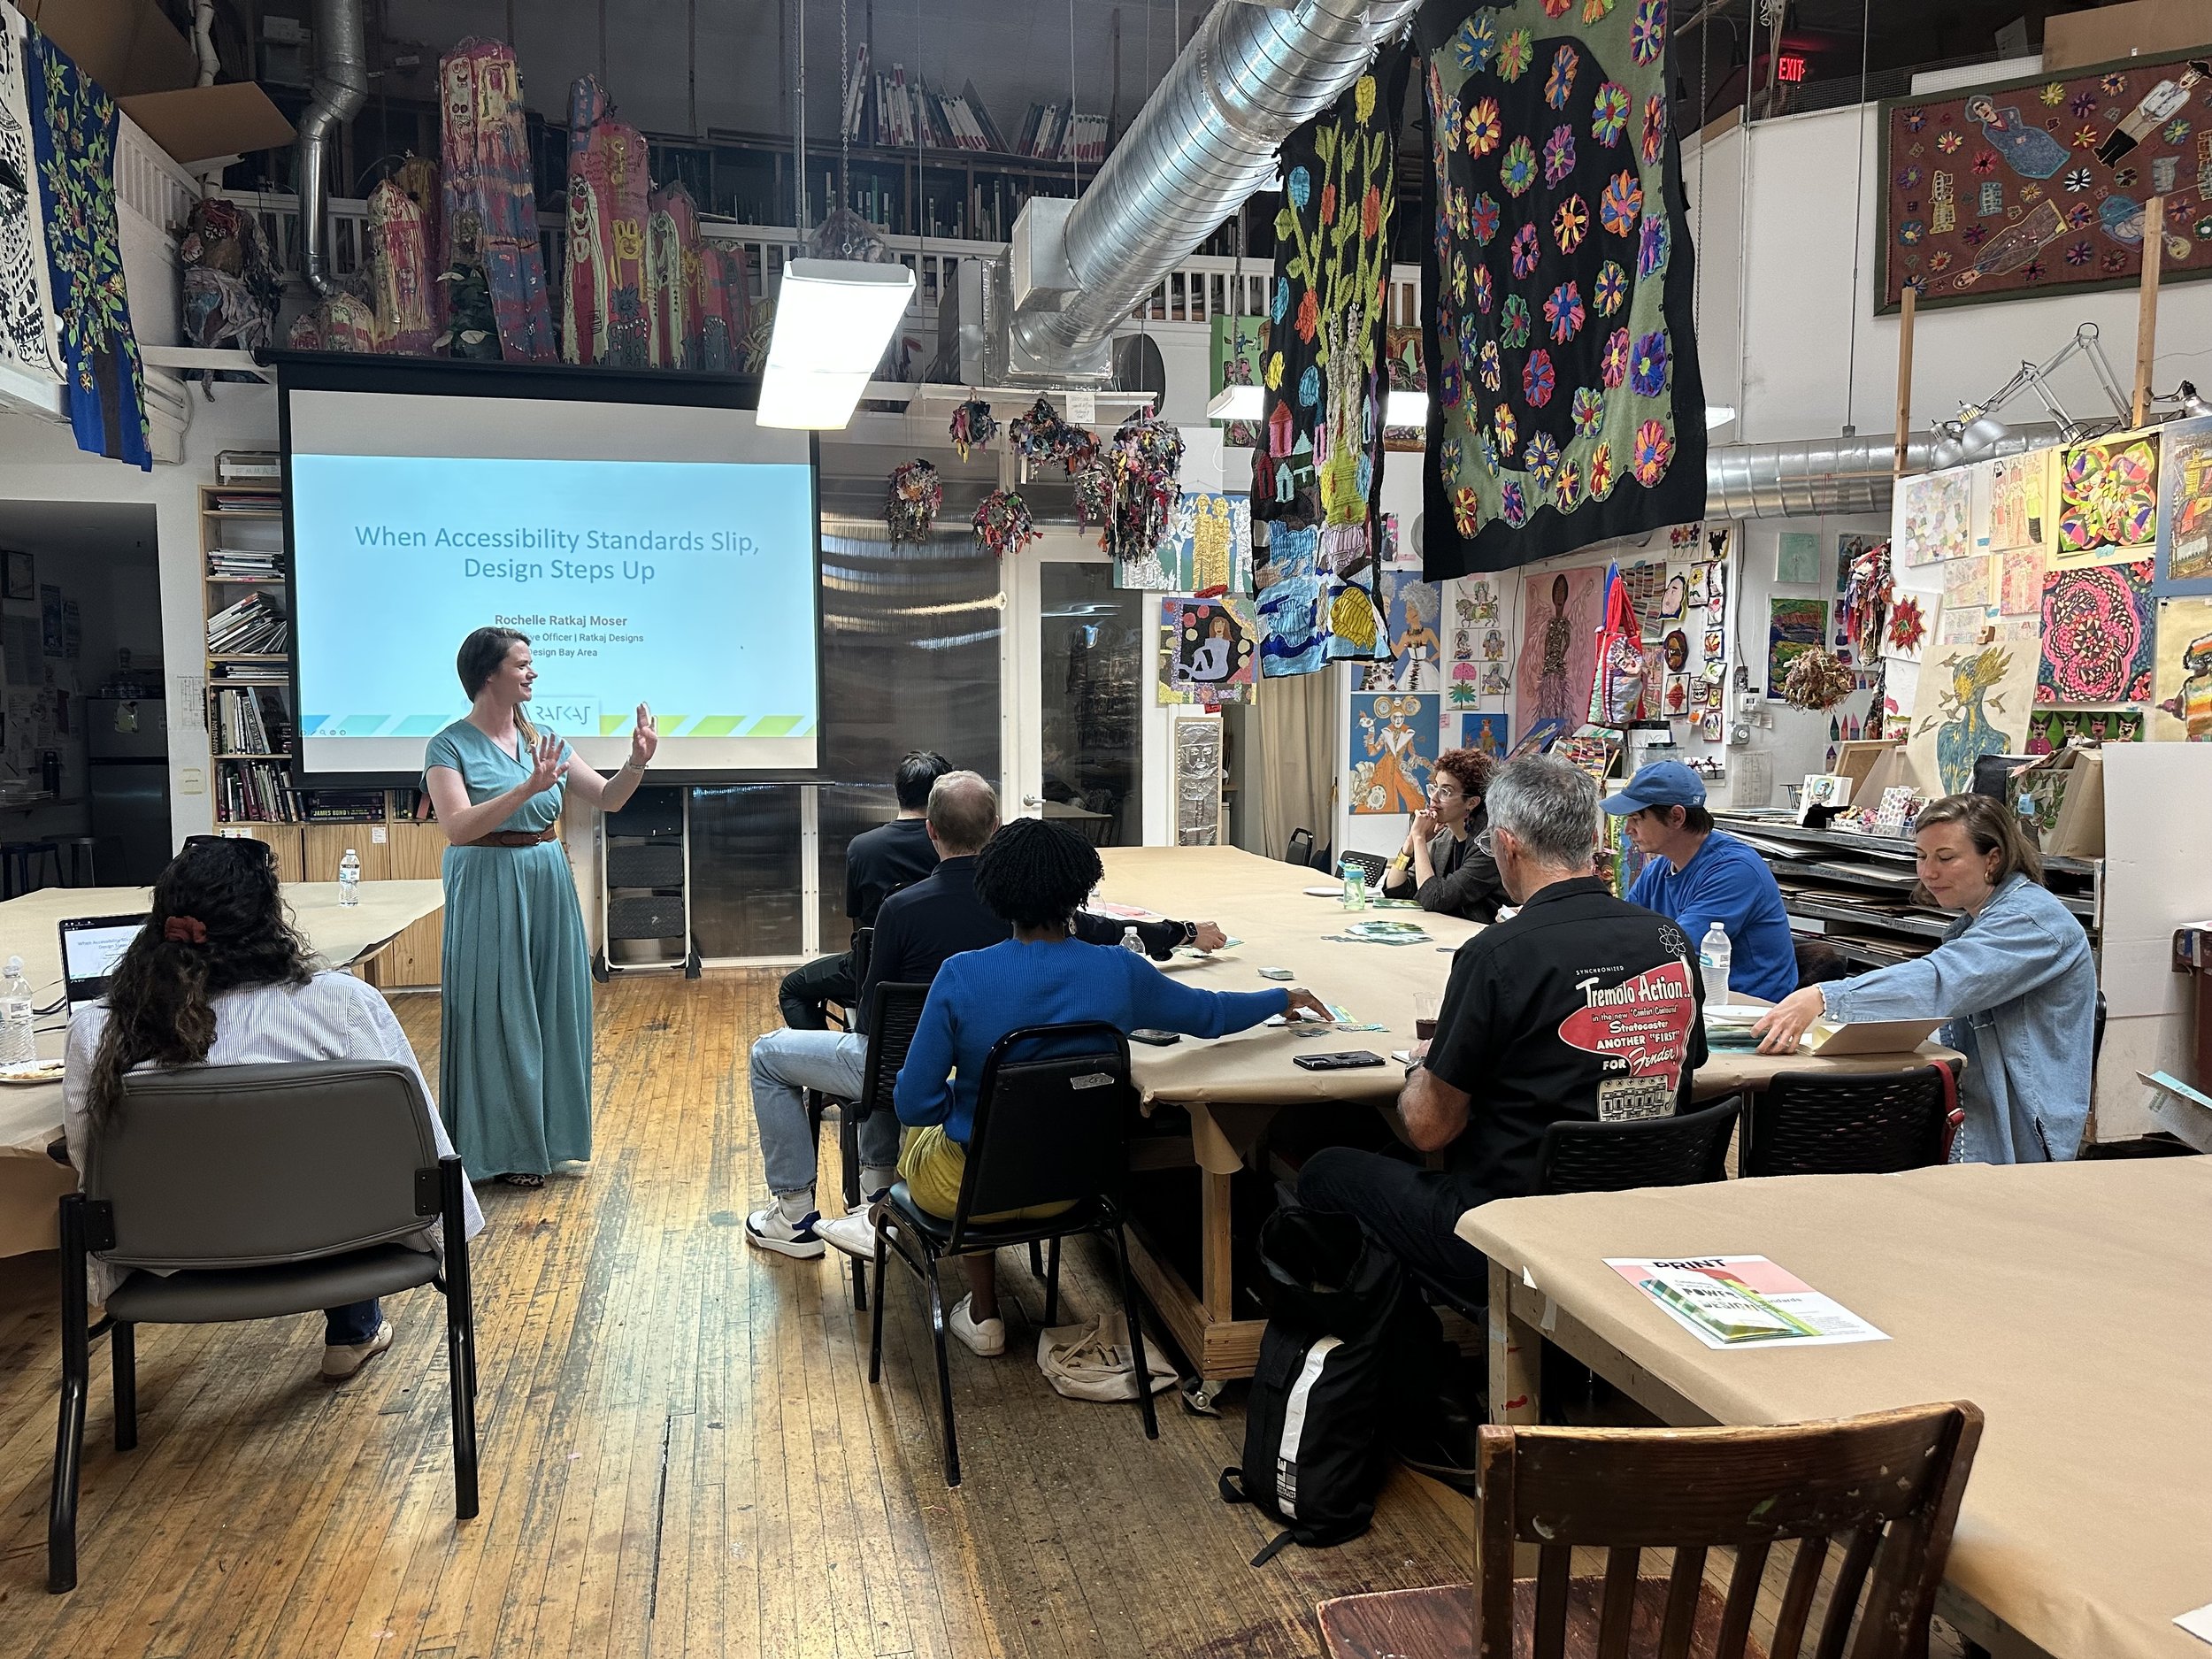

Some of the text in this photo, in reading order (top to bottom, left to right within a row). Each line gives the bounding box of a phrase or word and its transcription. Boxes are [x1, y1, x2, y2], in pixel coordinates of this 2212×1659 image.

[1778, 58, 1803, 81] EXIT
[355, 526, 759, 556] When Accessibility Standards Slip,
[465, 558, 655, 585] Design Steps Up
[495, 614, 628, 628] Rochelle Ratkaj Moser
[542, 633, 572, 641] Officer
[579, 634, 606, 643] Ratkaj
[609, 634, 644, 644] Designs
[558, 649, 575, 658] Bay
[535, 706, 591, 725] RATKAJ
[1576, 965, 1624, 976] SYNCHRONIZED
[1575, 977, 1635, 1009] Tremolo
[1601, 1012, 1612, 1021] the
[1609, 1020, 1668, 1033] Stratocaster
[1596, 1031, 1680, 1050] ANOTHER "FIRST"
[1602, 1059, 1627, 1070] FOR
[1653, 1259, 1726, 1270] PRINT
